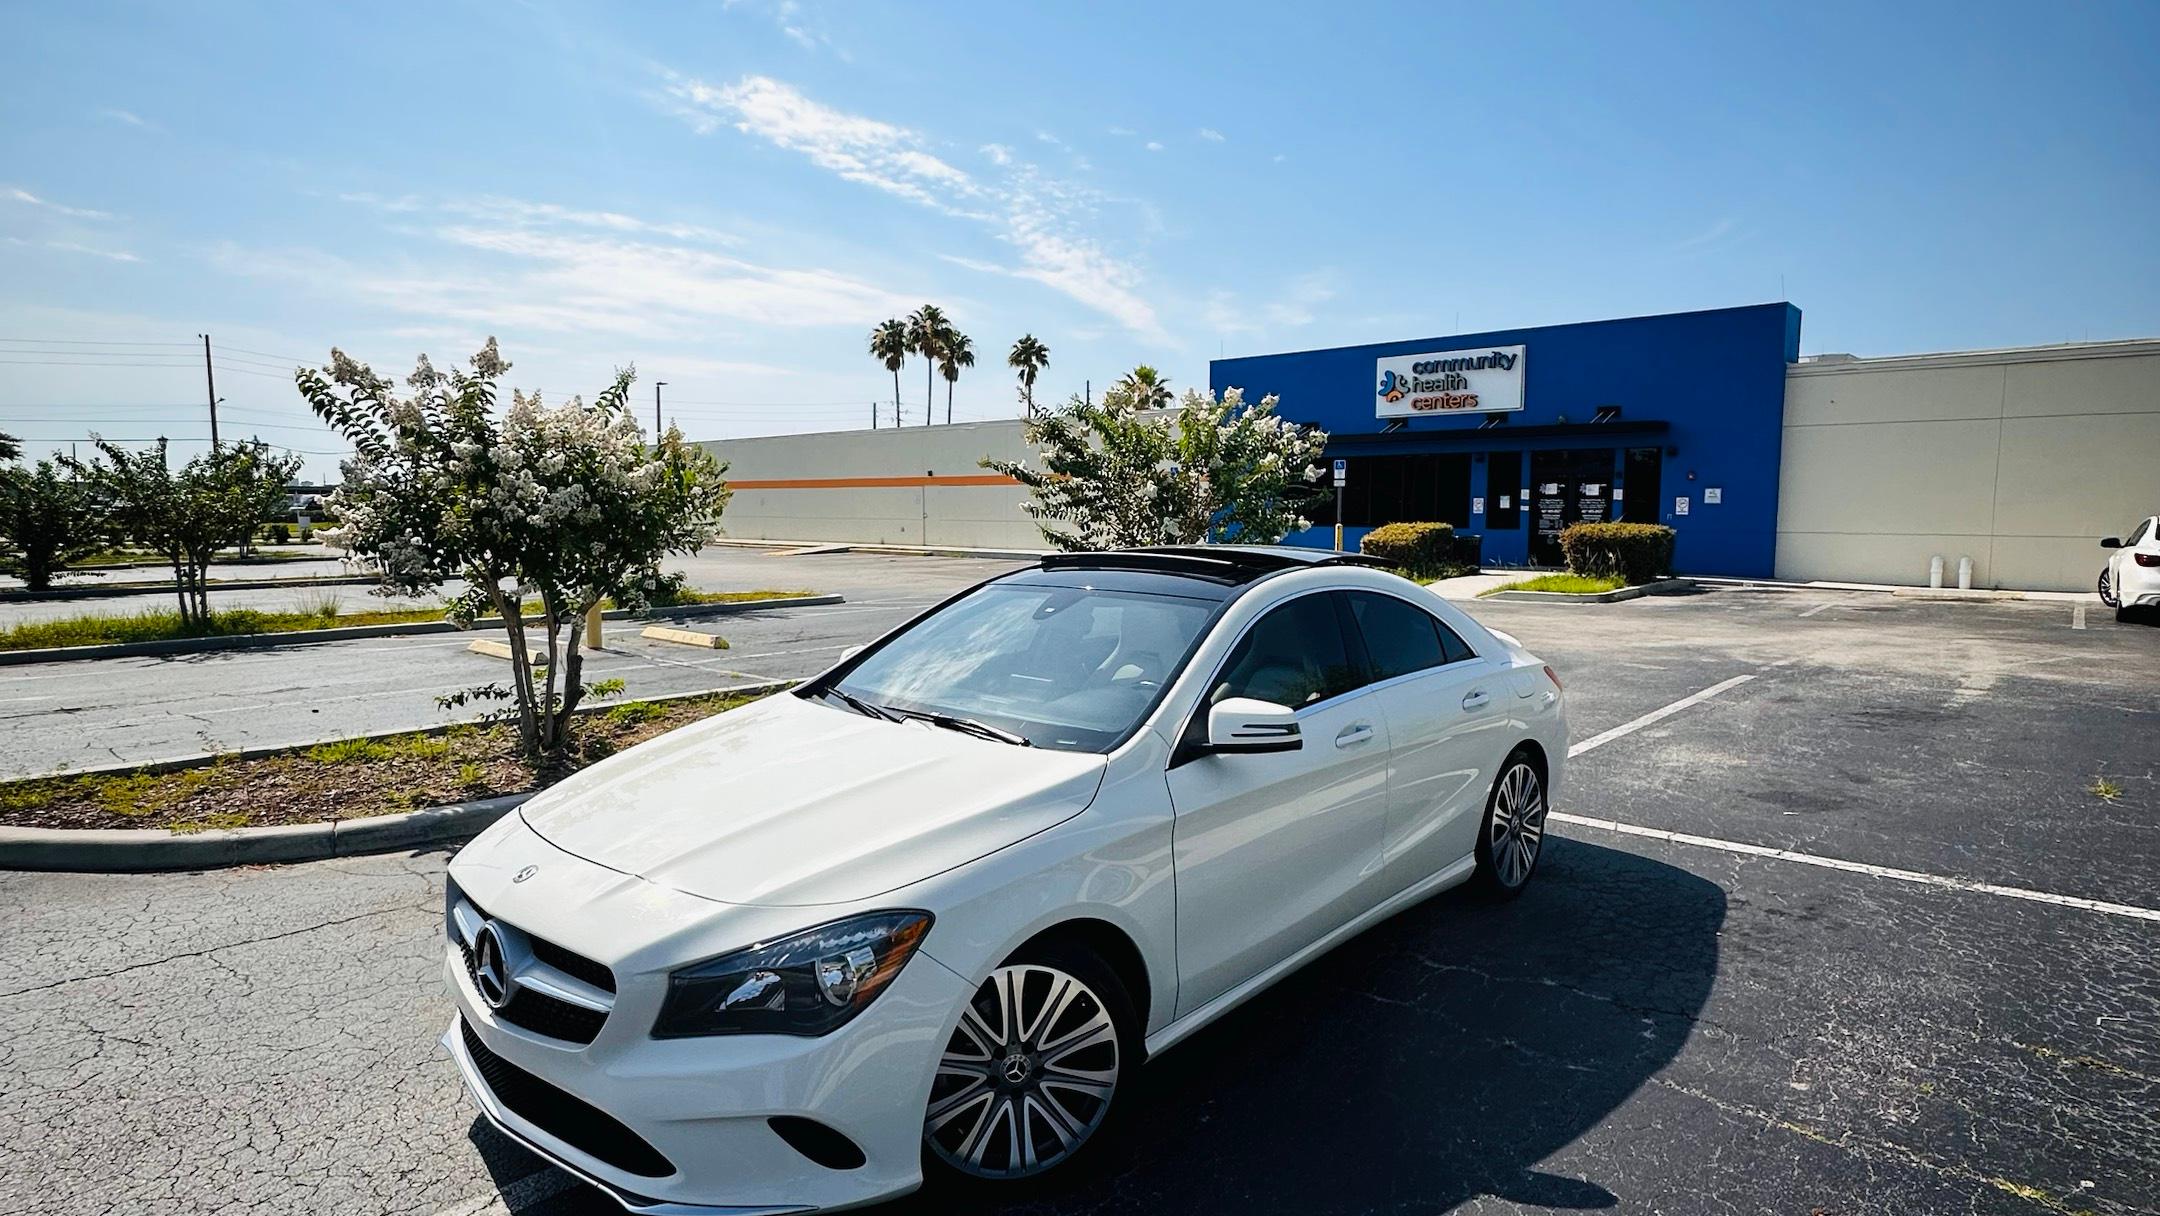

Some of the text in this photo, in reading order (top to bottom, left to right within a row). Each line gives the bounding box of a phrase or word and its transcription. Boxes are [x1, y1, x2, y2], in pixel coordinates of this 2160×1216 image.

[1412, 351, 1517, 375] community
[1412, 373, 1468, 393] health
[1411, 392, 1479, 410] centers
